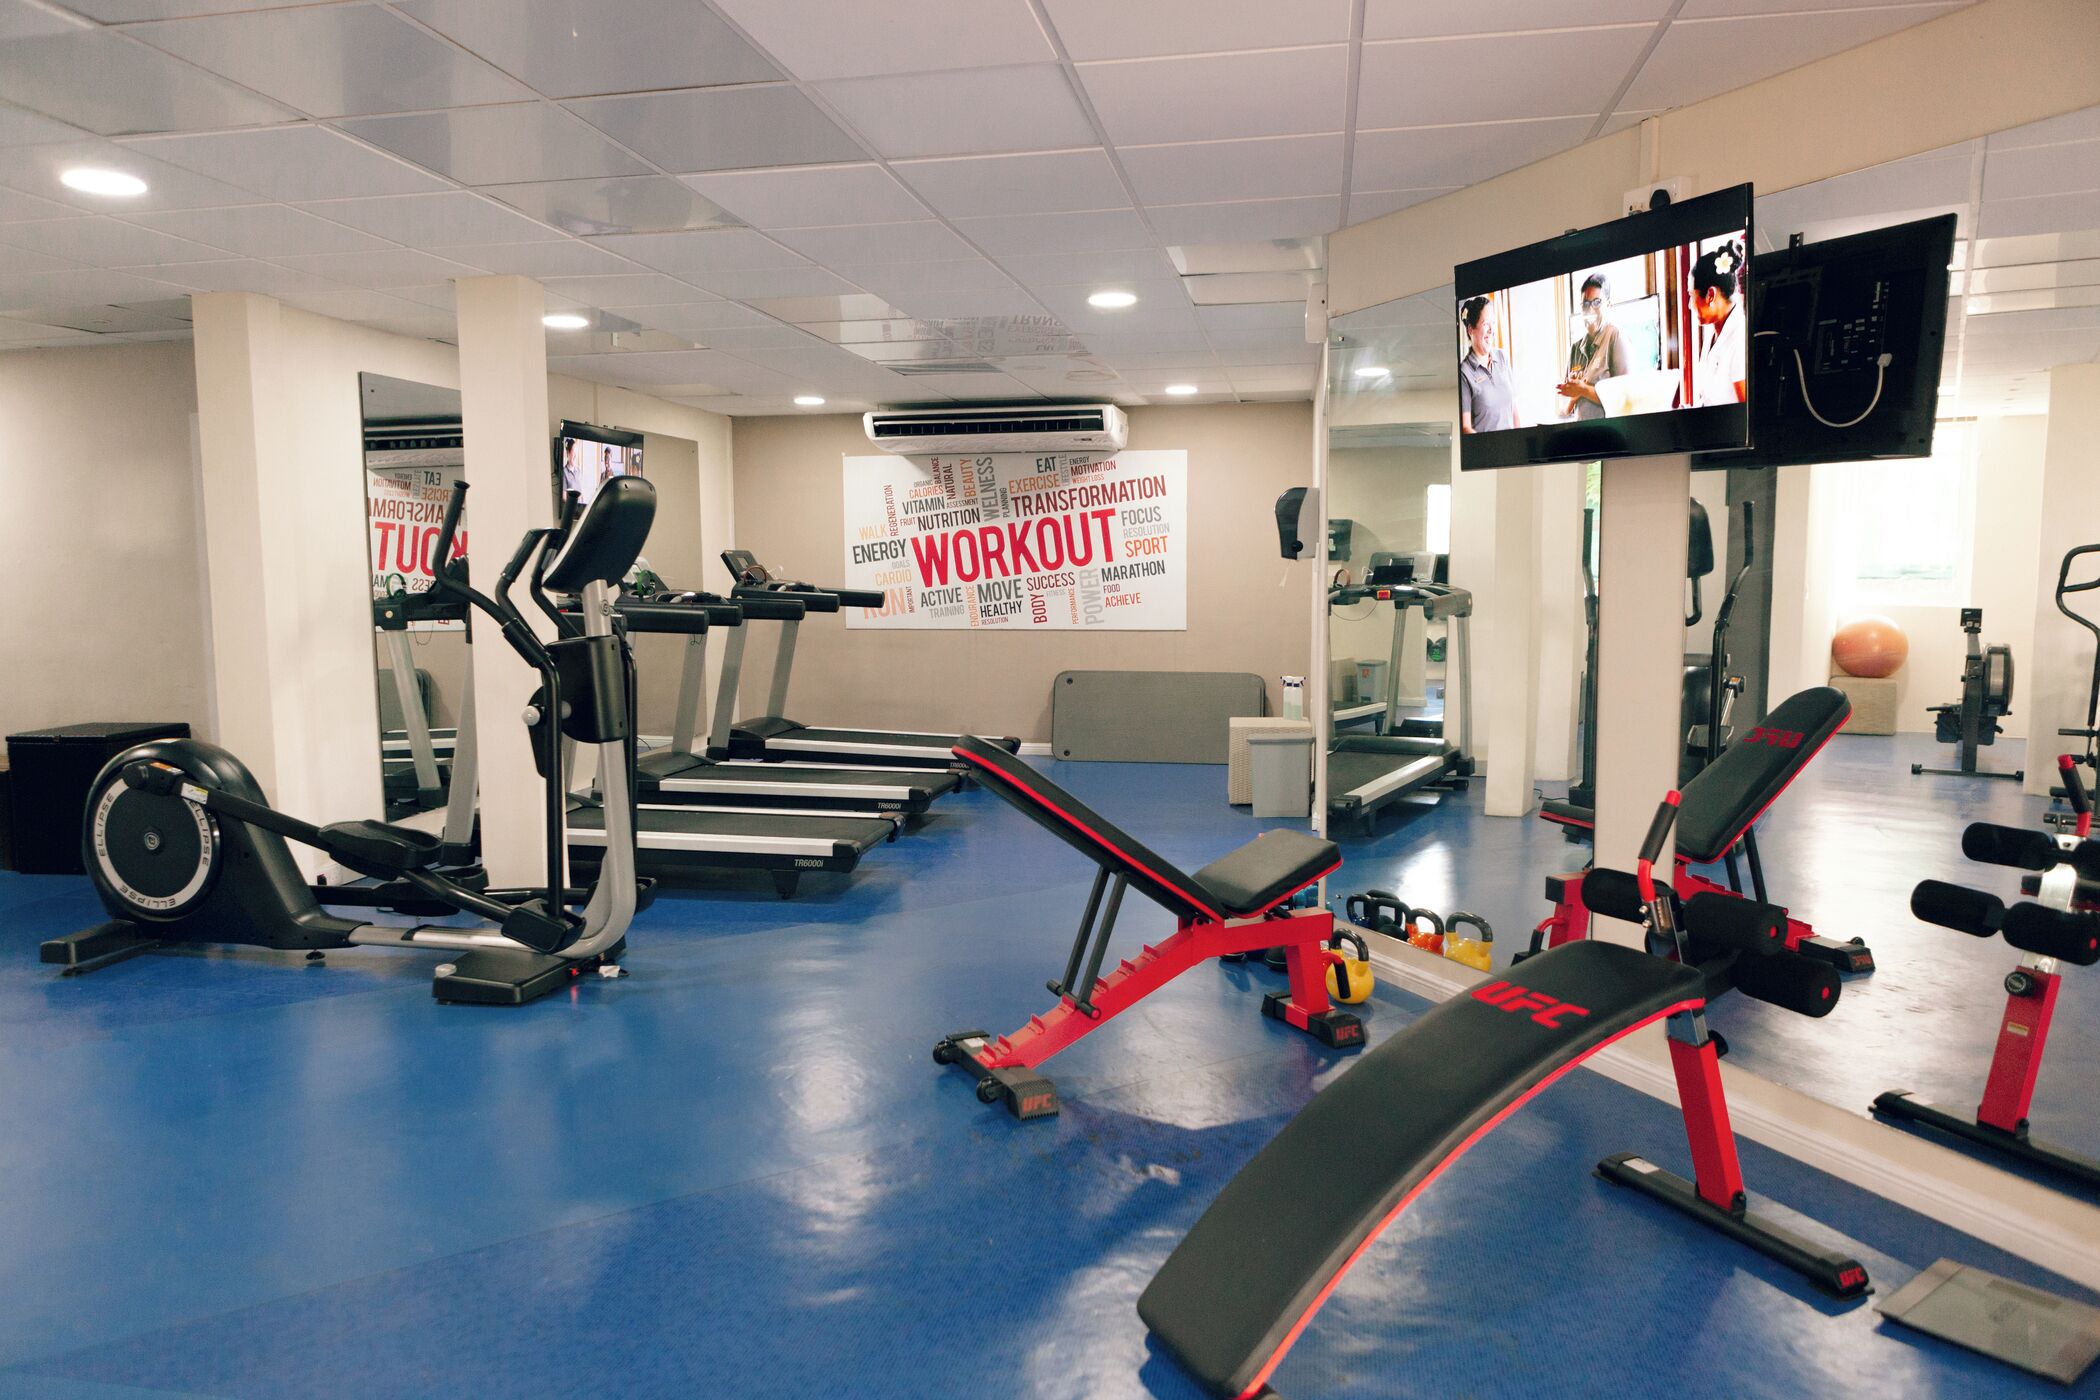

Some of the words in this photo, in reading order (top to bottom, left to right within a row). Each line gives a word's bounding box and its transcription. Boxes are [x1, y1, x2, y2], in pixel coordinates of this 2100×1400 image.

[931, 457, 942, 484] BALANCE
[1036, 456, 1056, 473] EAT
[1070, 456, 1089, 465] ENERGY
[1070, 460, 1116, 476] MOTIVATION
[943, 464, 956, 500] NATURAL
[960, 458, 977, 497] BEAUTY
[1009, 474, 1060, 494] EXERCISE
[1072, 475, 1091, 483] WEIGHT
[909, 485, 944, 499] CALORIES
[976, 456, 1000, 522] WELNESS
[1010, 475, 1167, 518] TRANSFORMATION
[883, 484, 899, 536] REGENERATION
[902, 496, 945, 515] VITAMIN
[946, 498, 979, 508] ASSESSMENT
[1000, 488, 1010, 518] PLANNING
[900, 517, 916, 526] FRUIT
[917, 508, 981, 531] NUTRITION
[1121, 506, 1161, 526] FOCUS
[859, 524, 887, 540] WALK
[1123, 523, 1170, 539] RESOLUTION
[852, 539, 906, 564] ENERGY
[910, 508, 1116, 588] WORKOUT
[1125, 536, 1168, 558] SPORT
[875, 569, 912, 586] CARDIO
[1026, 572, 1076, 591] SUCCESS
[1101, 560, 1166, 582] MARATHON
[906, 586, 915, 613] IMPORTANT
[920, 587, 963, 608] ACTIVE
[977, 578, 1024, 604] MOVE
[1079, 568, 1104, 626] POWER
[1103, 584, 1121, 594] FOOD
[965, 585, 980, 627] ENDURANCE
[980, 600, 1022, 618] HEALTHY
[1031, 593, 1048, 624] BODY
[1068, 586, 1079, 625] PERFORMANCE
[1105, 592, 1142, 608] ACHIEVE
[929, 605, 965, 619] TRAINING
[877, 802, 902, 810] TR6000i
[97, 793, 115, 857] ELLIPSE
[794, 858, 824, 868] TR6000i
[120, 884, 177, 907] ELLIPSE
[1471, 981, 1590, 1029] UFC
[1335, 1024, 1359, 1041] UFC
[1022, 1093, 1053, 1113] UFC
[1839, 1266, 1865, 1288] UFC
